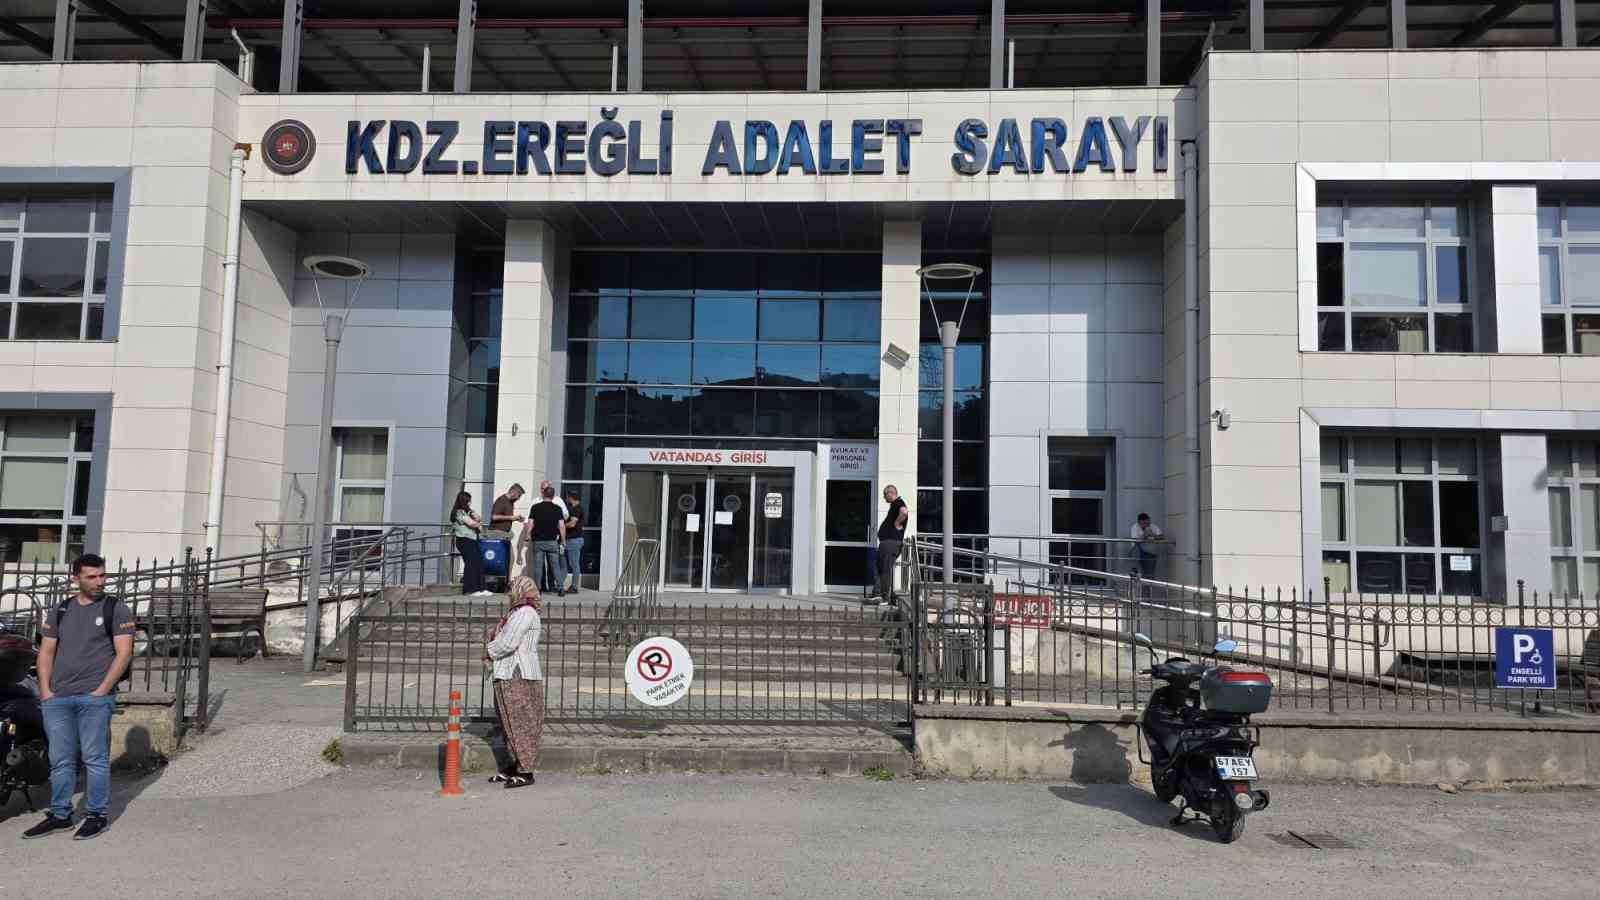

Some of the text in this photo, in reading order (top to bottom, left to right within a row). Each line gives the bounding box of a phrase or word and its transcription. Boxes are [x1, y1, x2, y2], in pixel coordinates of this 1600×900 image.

[701, 118, 922, 176] ADALET
[951, 116, 1169, 176] SARAYI
[649, 451, 767, 464] VATANDAŞ GİRİŞİ
[1513, 634, 1535, 663] P
[1511, 666, 1542, 675] ENGELLİ
[1507, 675, 1546, 684] PARK YERİ
[646, 684, 664, 697] PARK
